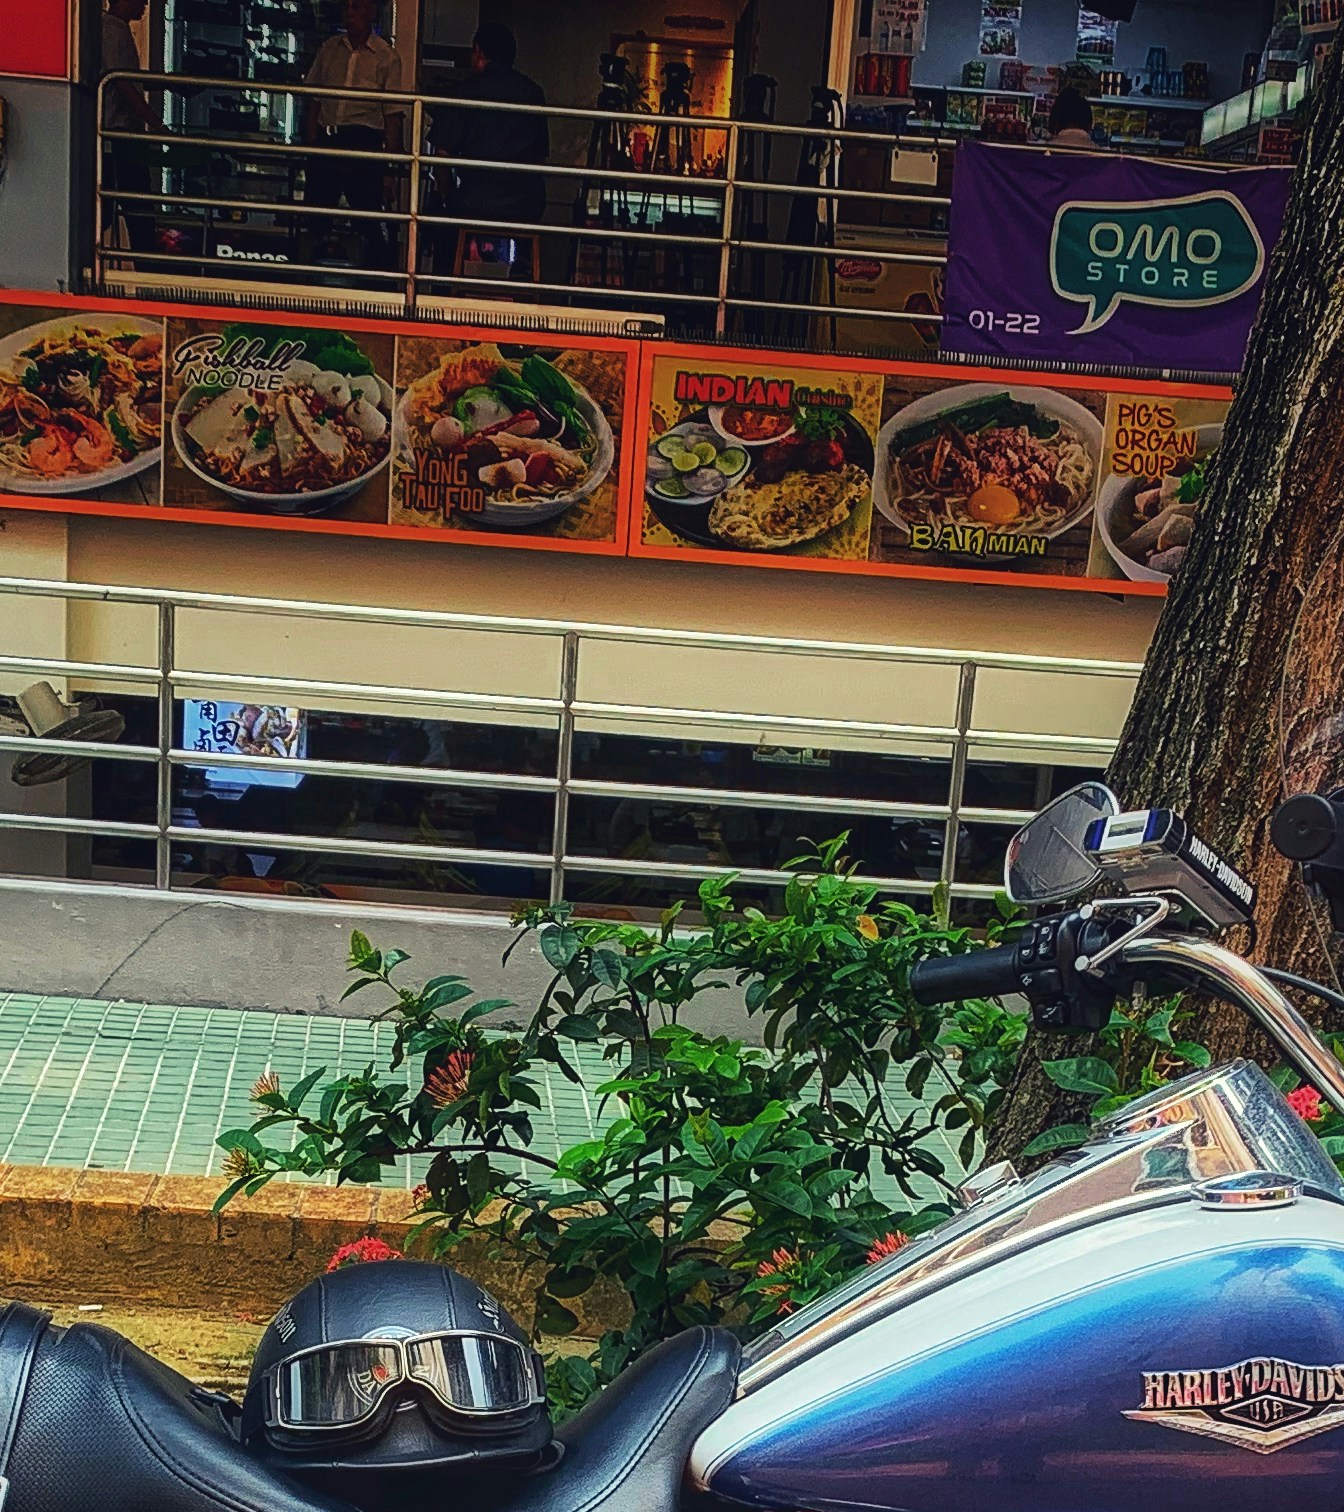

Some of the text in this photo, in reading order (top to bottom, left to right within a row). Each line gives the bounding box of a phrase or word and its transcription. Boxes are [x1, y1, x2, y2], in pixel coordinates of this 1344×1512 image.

[1088, 221, 1224, 265] OMO
[1085, 262, 1219, 289] STORE
[968, 309, 1041, 335] 01-22
[173, 334, 307, 377] Fishball
[185, 366, 285, 391] NOODLE
[675, 371, 794, 409] INDIAN
[1117, 402, 1177, 428] PIG'S
[1115, 428, 1197, 456] ORGAN
[414, 450, 469, 485] YONG
[1112, 452, 1177, 478] SOUP
[400, 471, 486, 520] TAU FOO
[987, 532, 1049, 556] MIAN
[1250, 1400, 1285, 1421] USA
